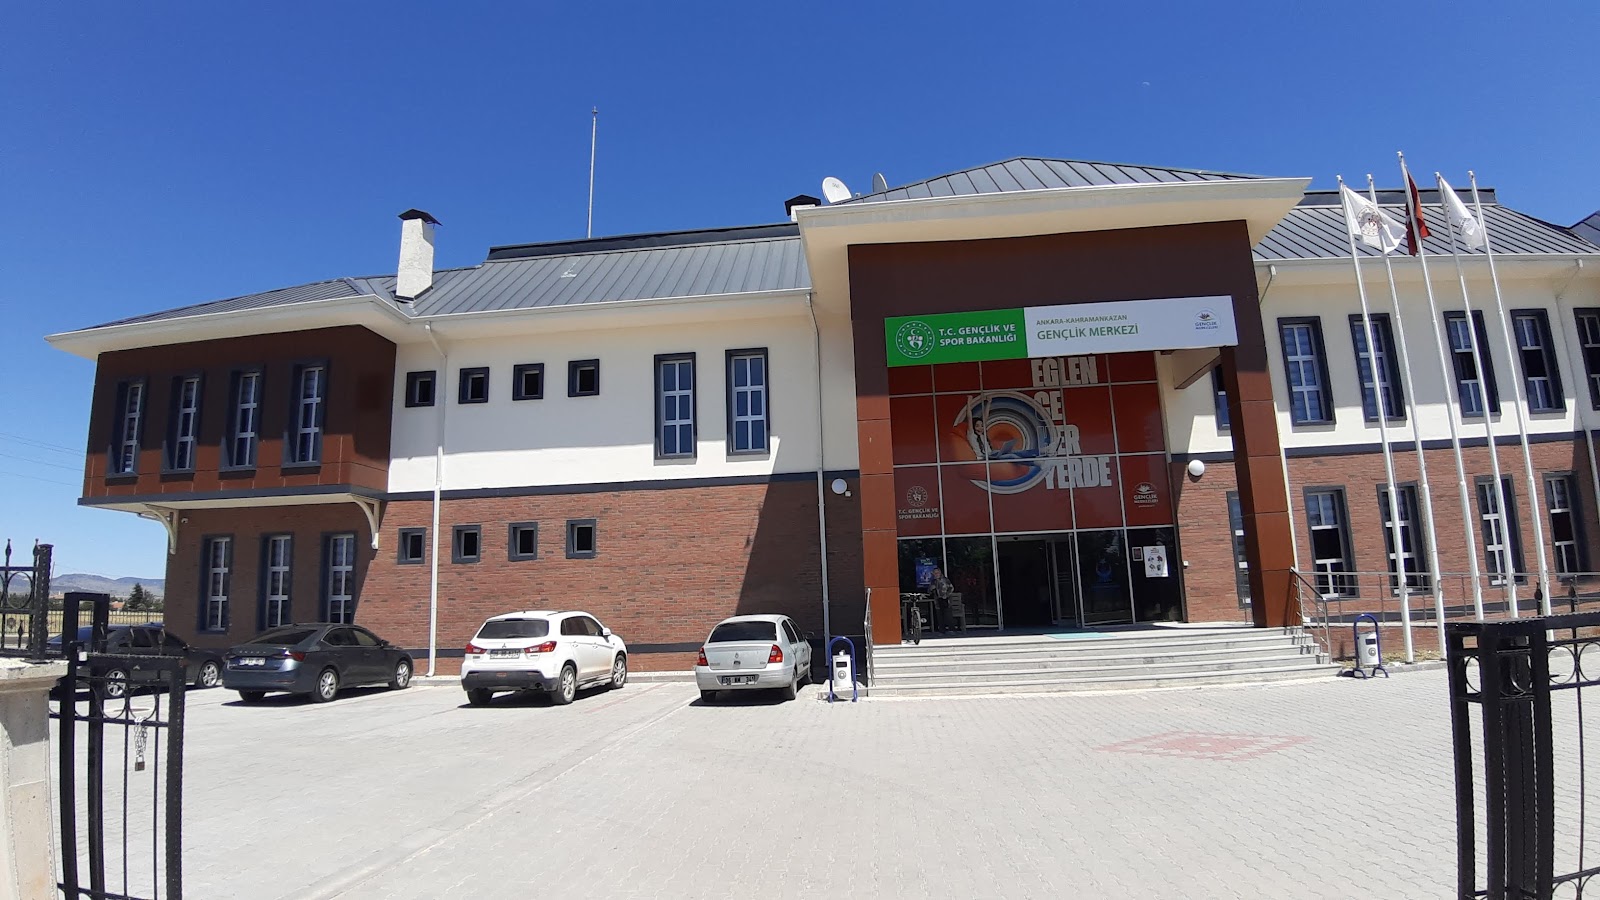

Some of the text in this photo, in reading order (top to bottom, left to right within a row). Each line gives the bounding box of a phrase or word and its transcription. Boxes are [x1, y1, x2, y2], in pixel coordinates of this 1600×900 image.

[1036, 314, 1128, 326] ANKARA-KAHRAMANKAZAN
[939, 324, 1016, 336] T.C. GENÇLİK VE
[1037, 323, 1139, 341] GENÇLİK MERKEZİ
[940, 333, 1017, 346] SPOR BAKANLIĞI
[1041, 457, 1112, 490] YERDE
